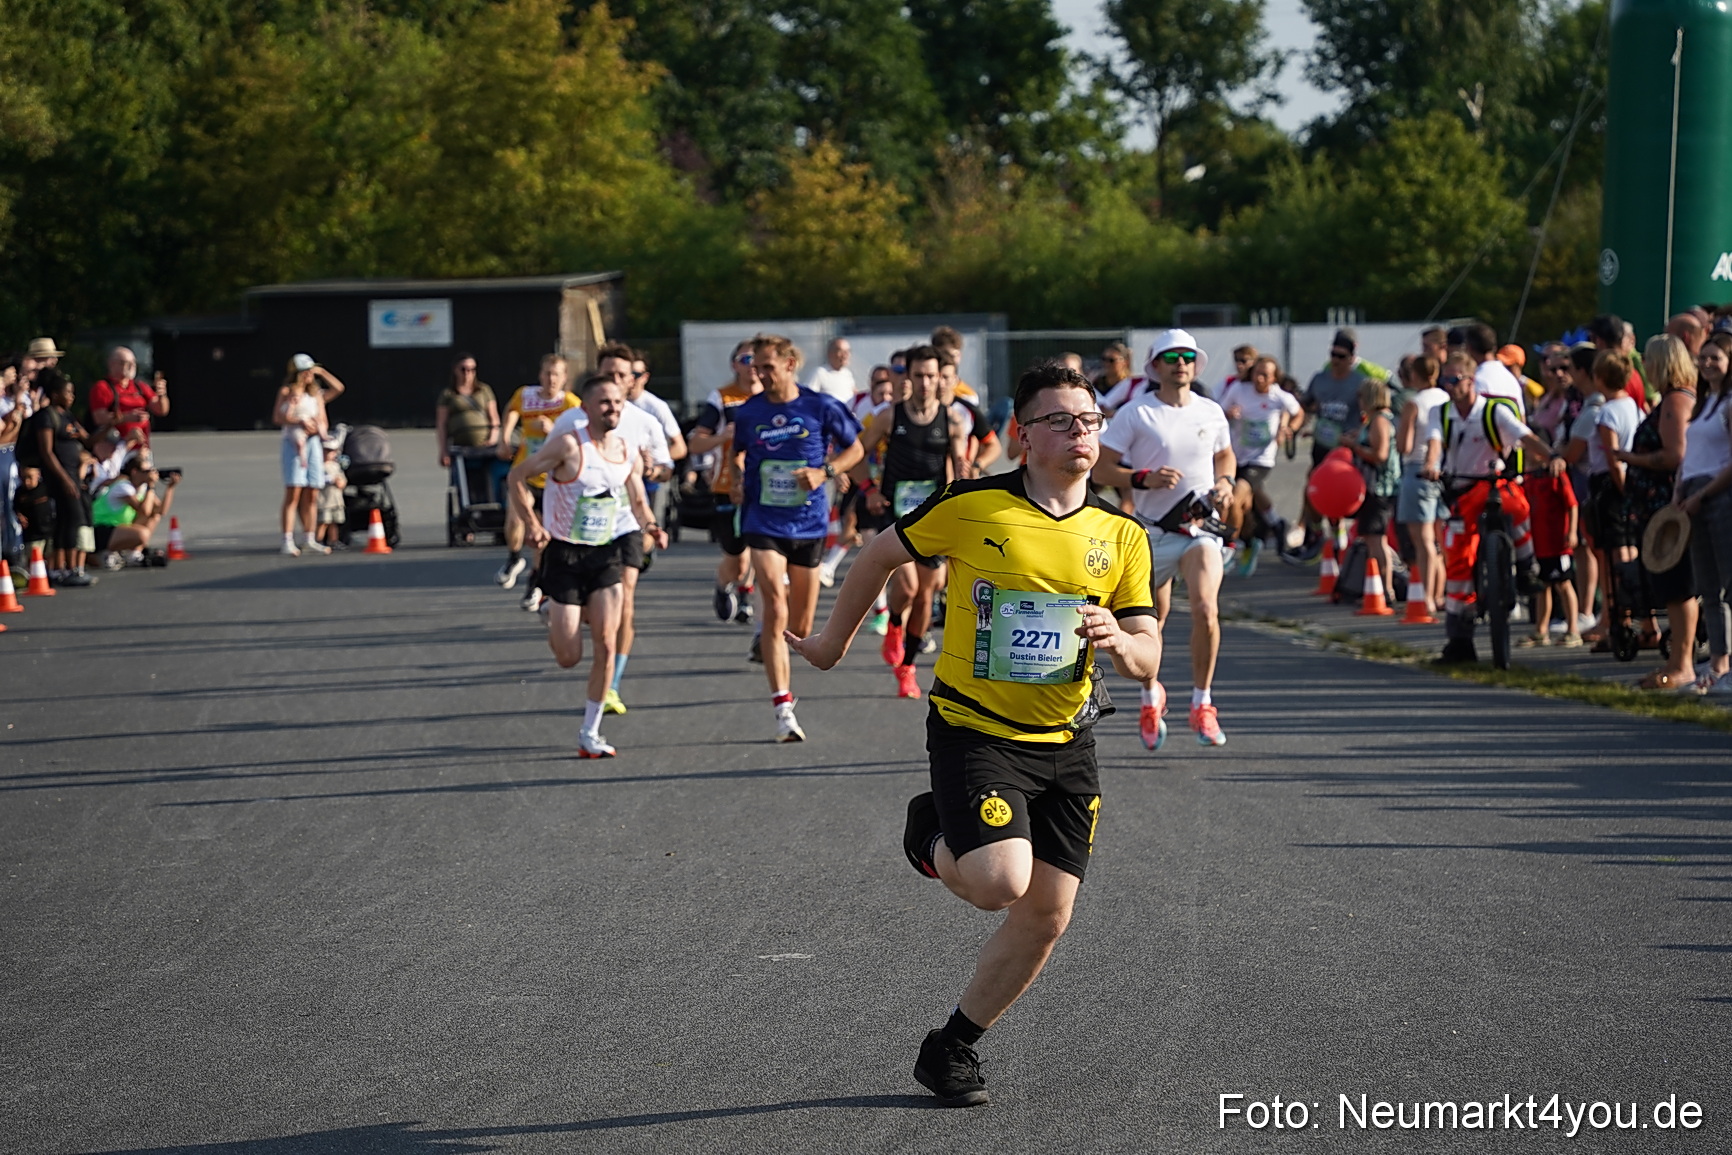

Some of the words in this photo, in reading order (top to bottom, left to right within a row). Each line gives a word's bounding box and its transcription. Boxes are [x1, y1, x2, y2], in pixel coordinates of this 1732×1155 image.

[1088, 550, 1109, 570] BVB
[1011, 629, 1061, 650] 2271
[1010, 651, 1036, 661] Dustin
[1038, 653, 1063, 663] Bielert
[984, 801, 1008, 820] BVB
